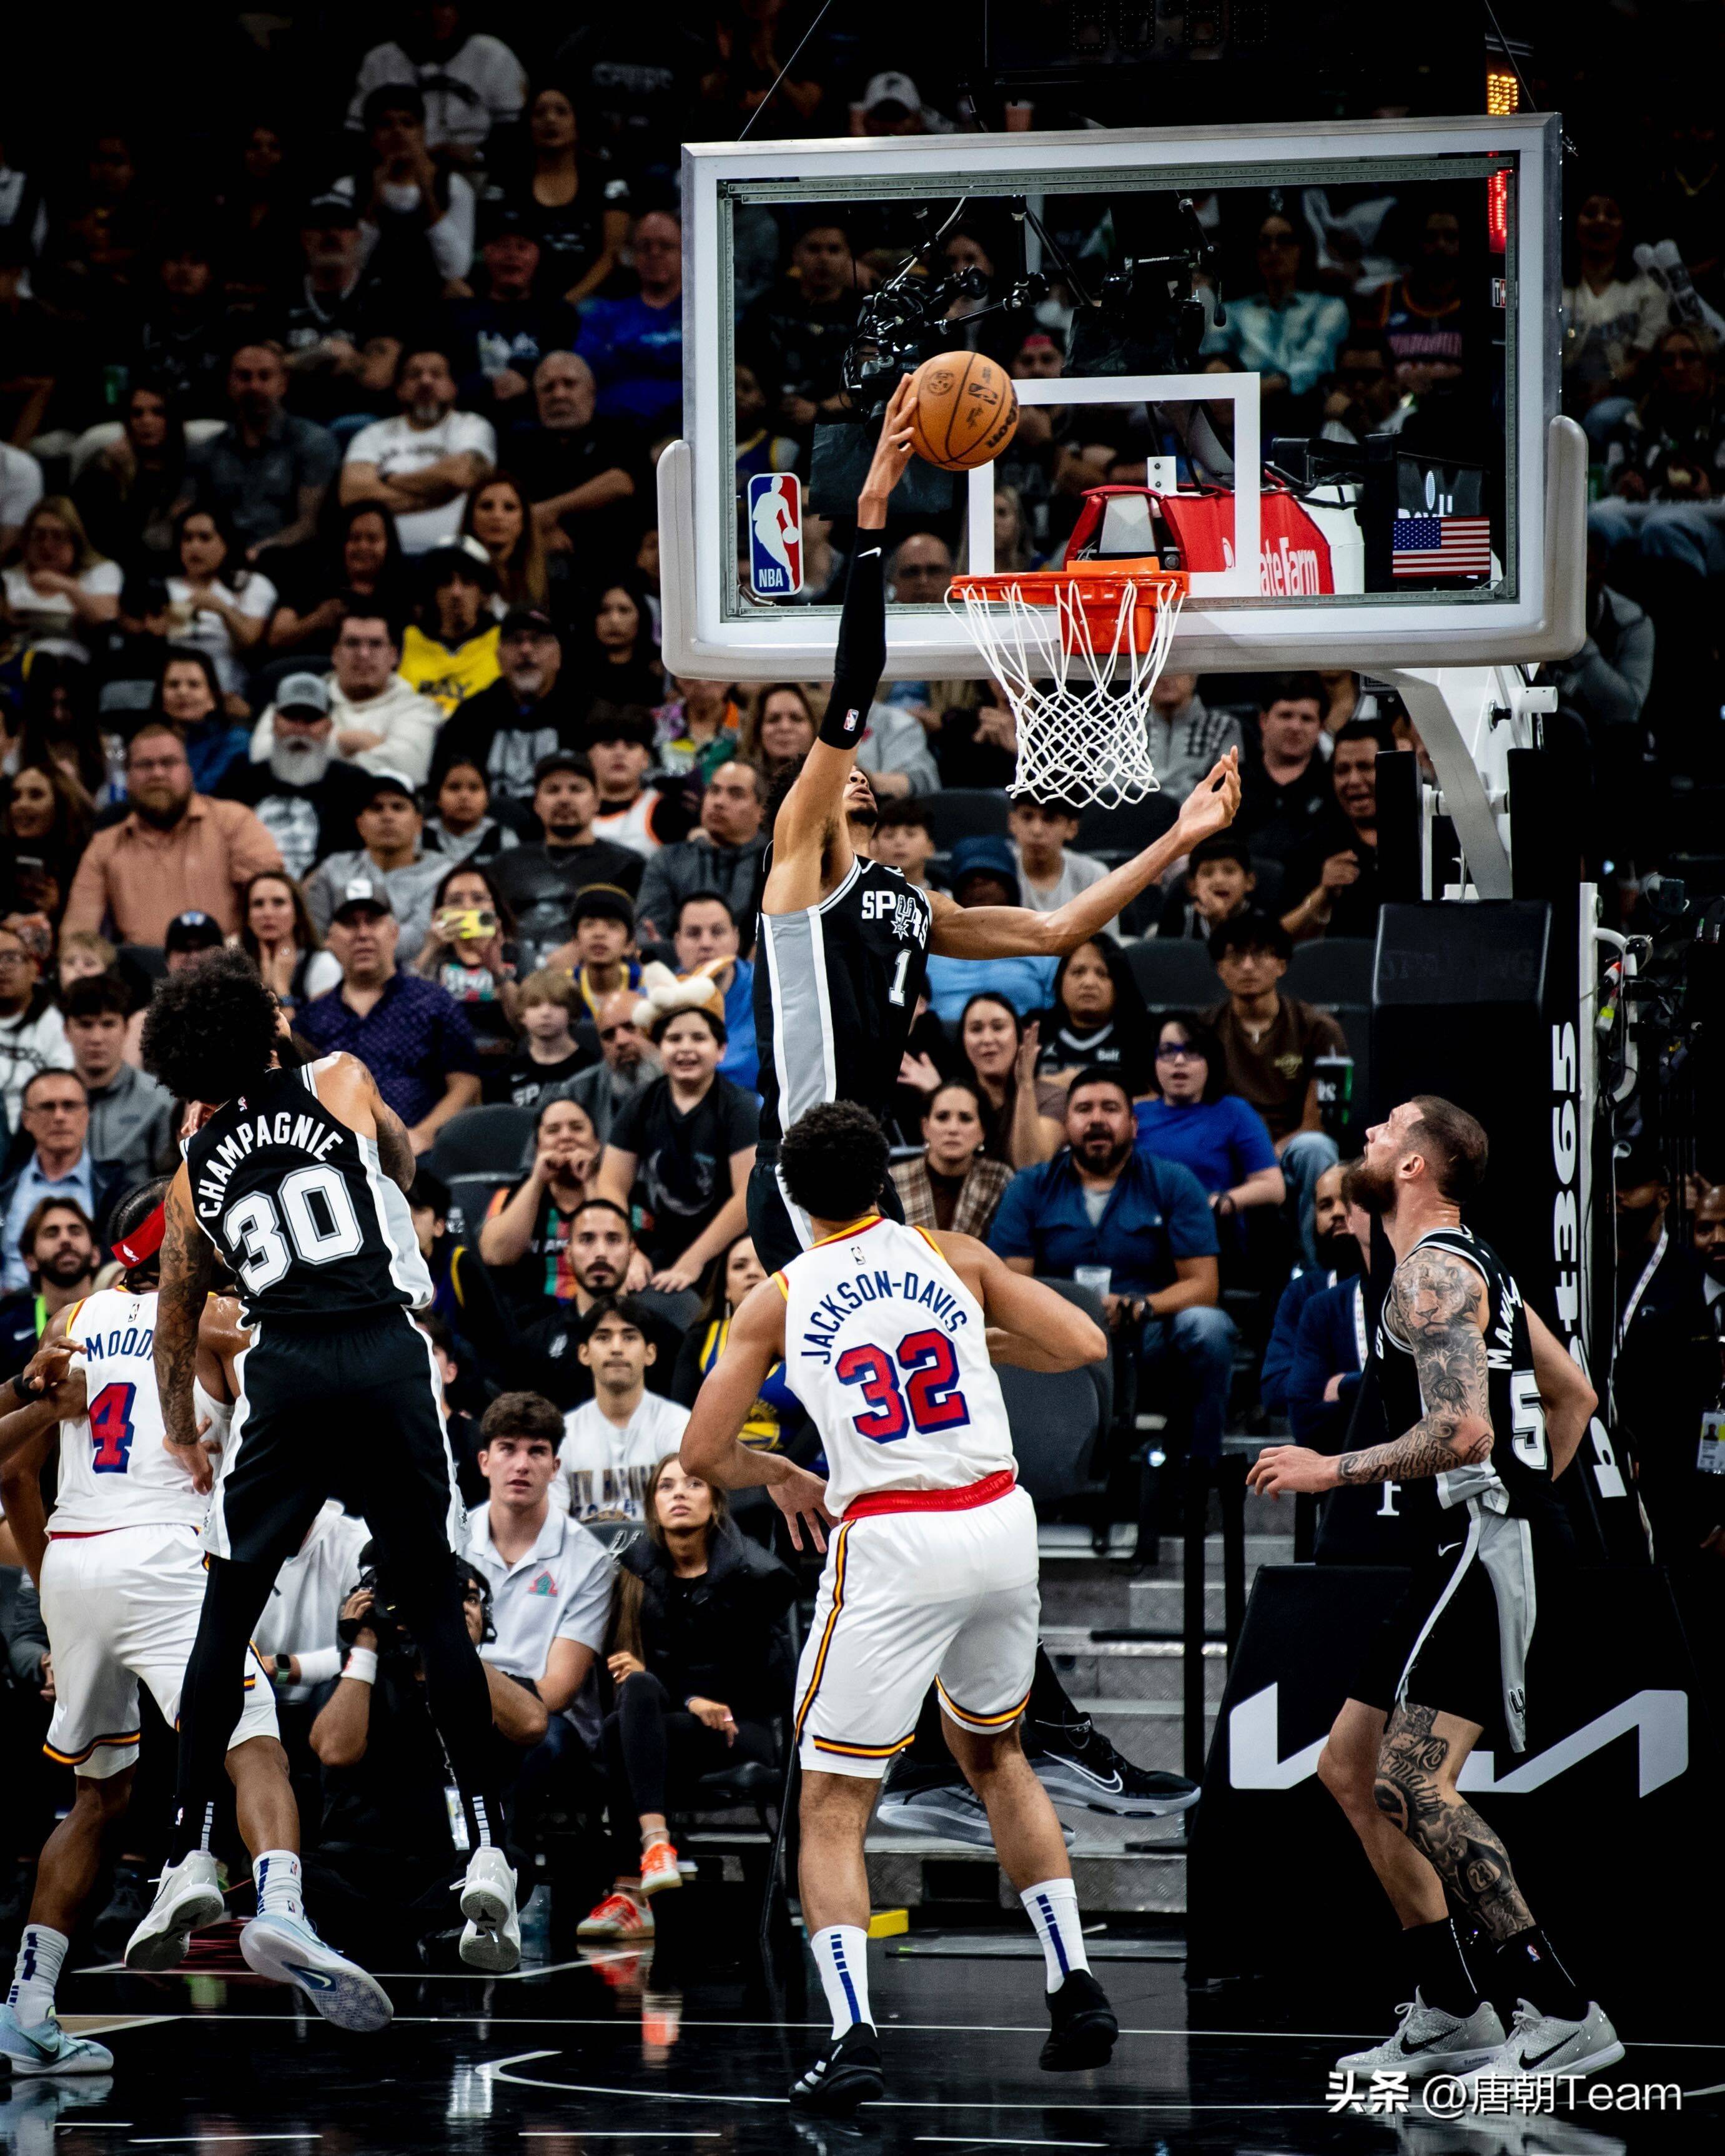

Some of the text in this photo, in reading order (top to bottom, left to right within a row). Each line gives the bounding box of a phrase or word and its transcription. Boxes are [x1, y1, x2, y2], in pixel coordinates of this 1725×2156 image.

[758, 568, 784, 588] NBA
[889, 948, 912, 1007] 1
[198, 1111, 344, 1218] CHAMPAGNIE
[222, 1162, 365, 1297] 30
[85, 1327, 154, 1362] MOOD
[801, 1270, 967, 1365] JACKSON-DAVIS
[88, 1382, 137, 1474] 4
[834, 1327, 971, 1445] 32
[1510, 1369, 1548, 1470] 5
[1230, 1681, 1689, 1798] KA
[1468, 1861, 1496, 1889] 23
